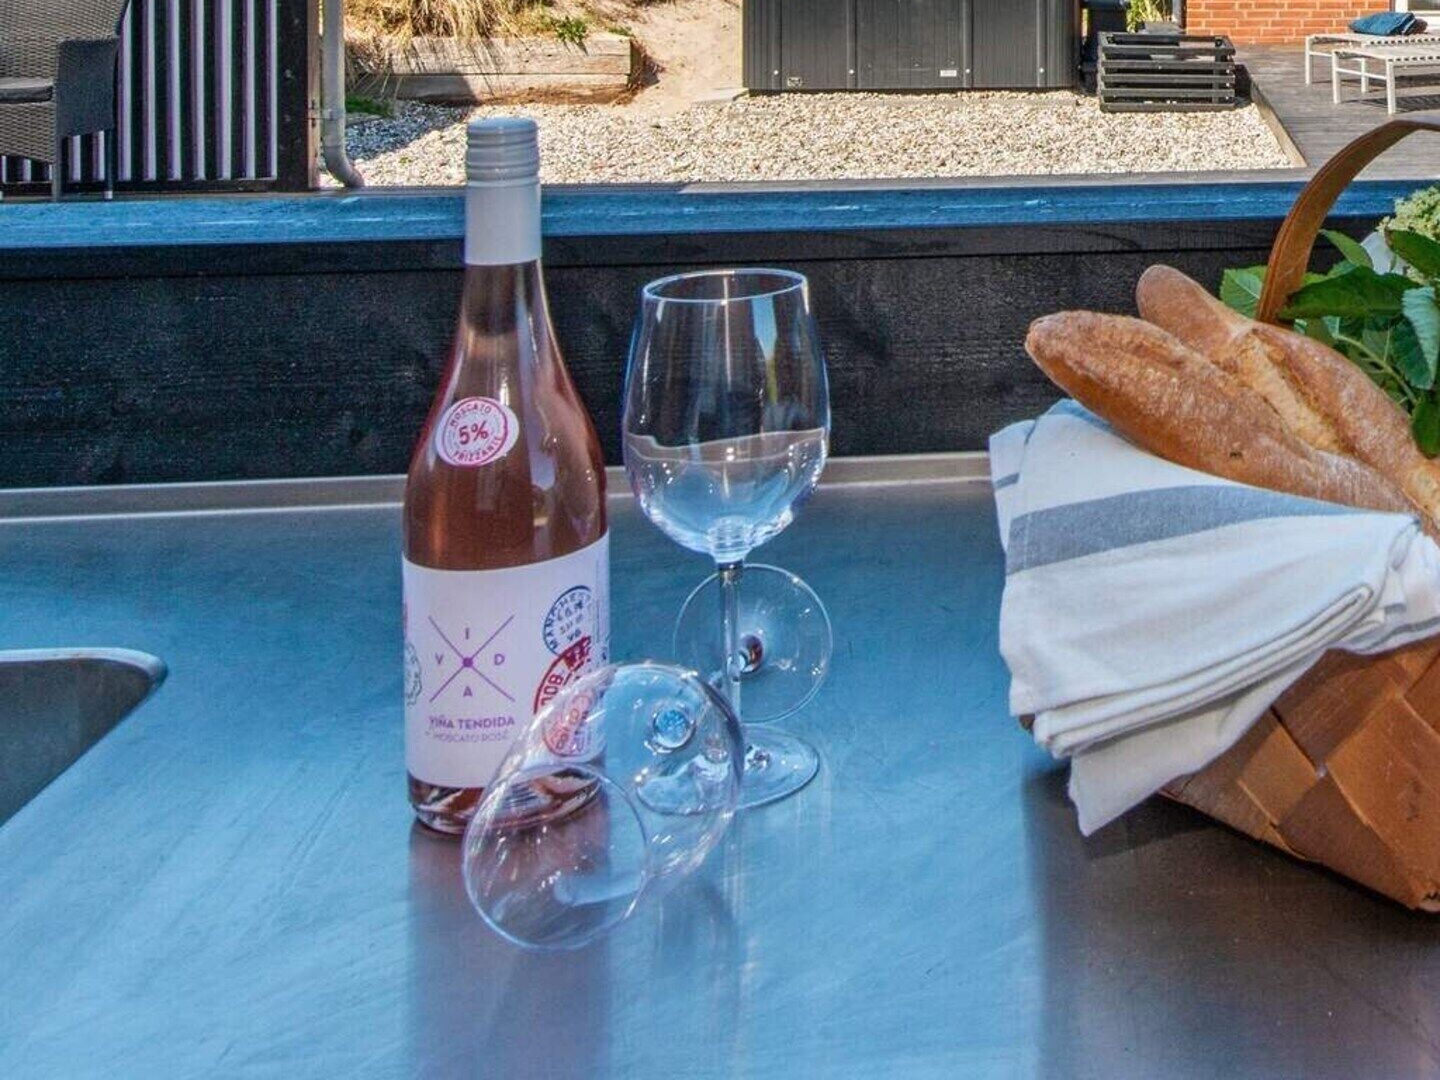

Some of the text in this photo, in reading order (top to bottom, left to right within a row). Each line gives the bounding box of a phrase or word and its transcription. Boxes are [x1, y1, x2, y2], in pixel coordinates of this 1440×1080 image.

[450, 404, 492, 427] MOSCATO
[459, 421, 489, 445] 5%
[458, 716, 515, 730] TENDIDA
